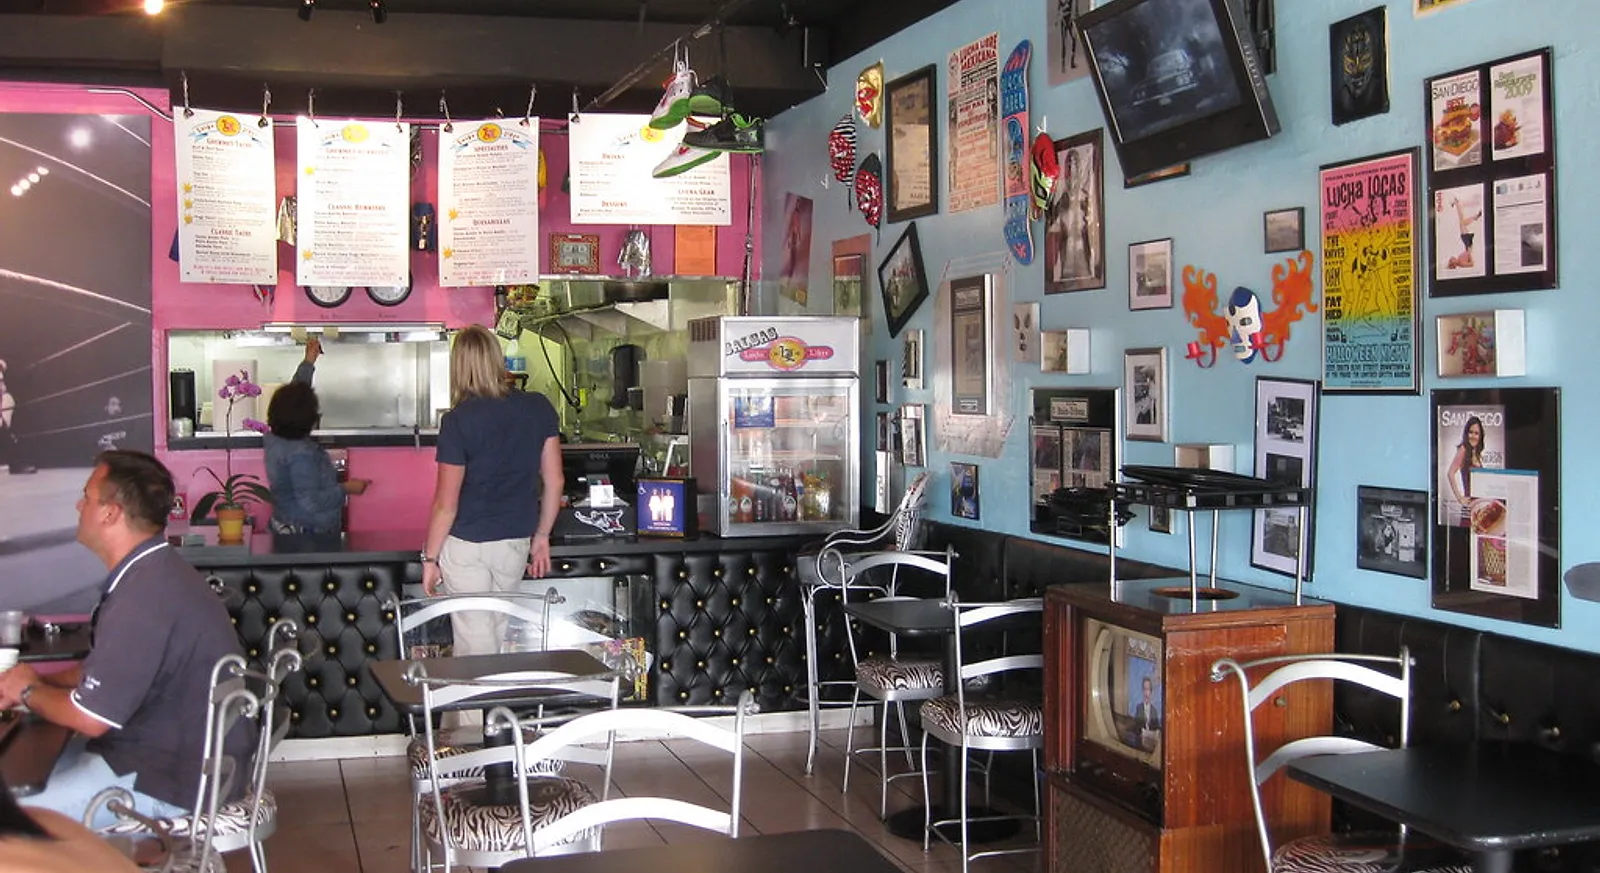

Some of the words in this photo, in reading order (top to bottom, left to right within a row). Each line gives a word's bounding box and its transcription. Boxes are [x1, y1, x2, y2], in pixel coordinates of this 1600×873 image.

[960, 50, 997, 70] MEXICANA
[1504, 81, 1534, 100] 2009
[1446, 96, 1465, 108] BEST
[1368, 172, 1407, 199] LOCAS
[1325, 296, 1342, 308] FAT
[725, 327, 779, 356] SALSAS
